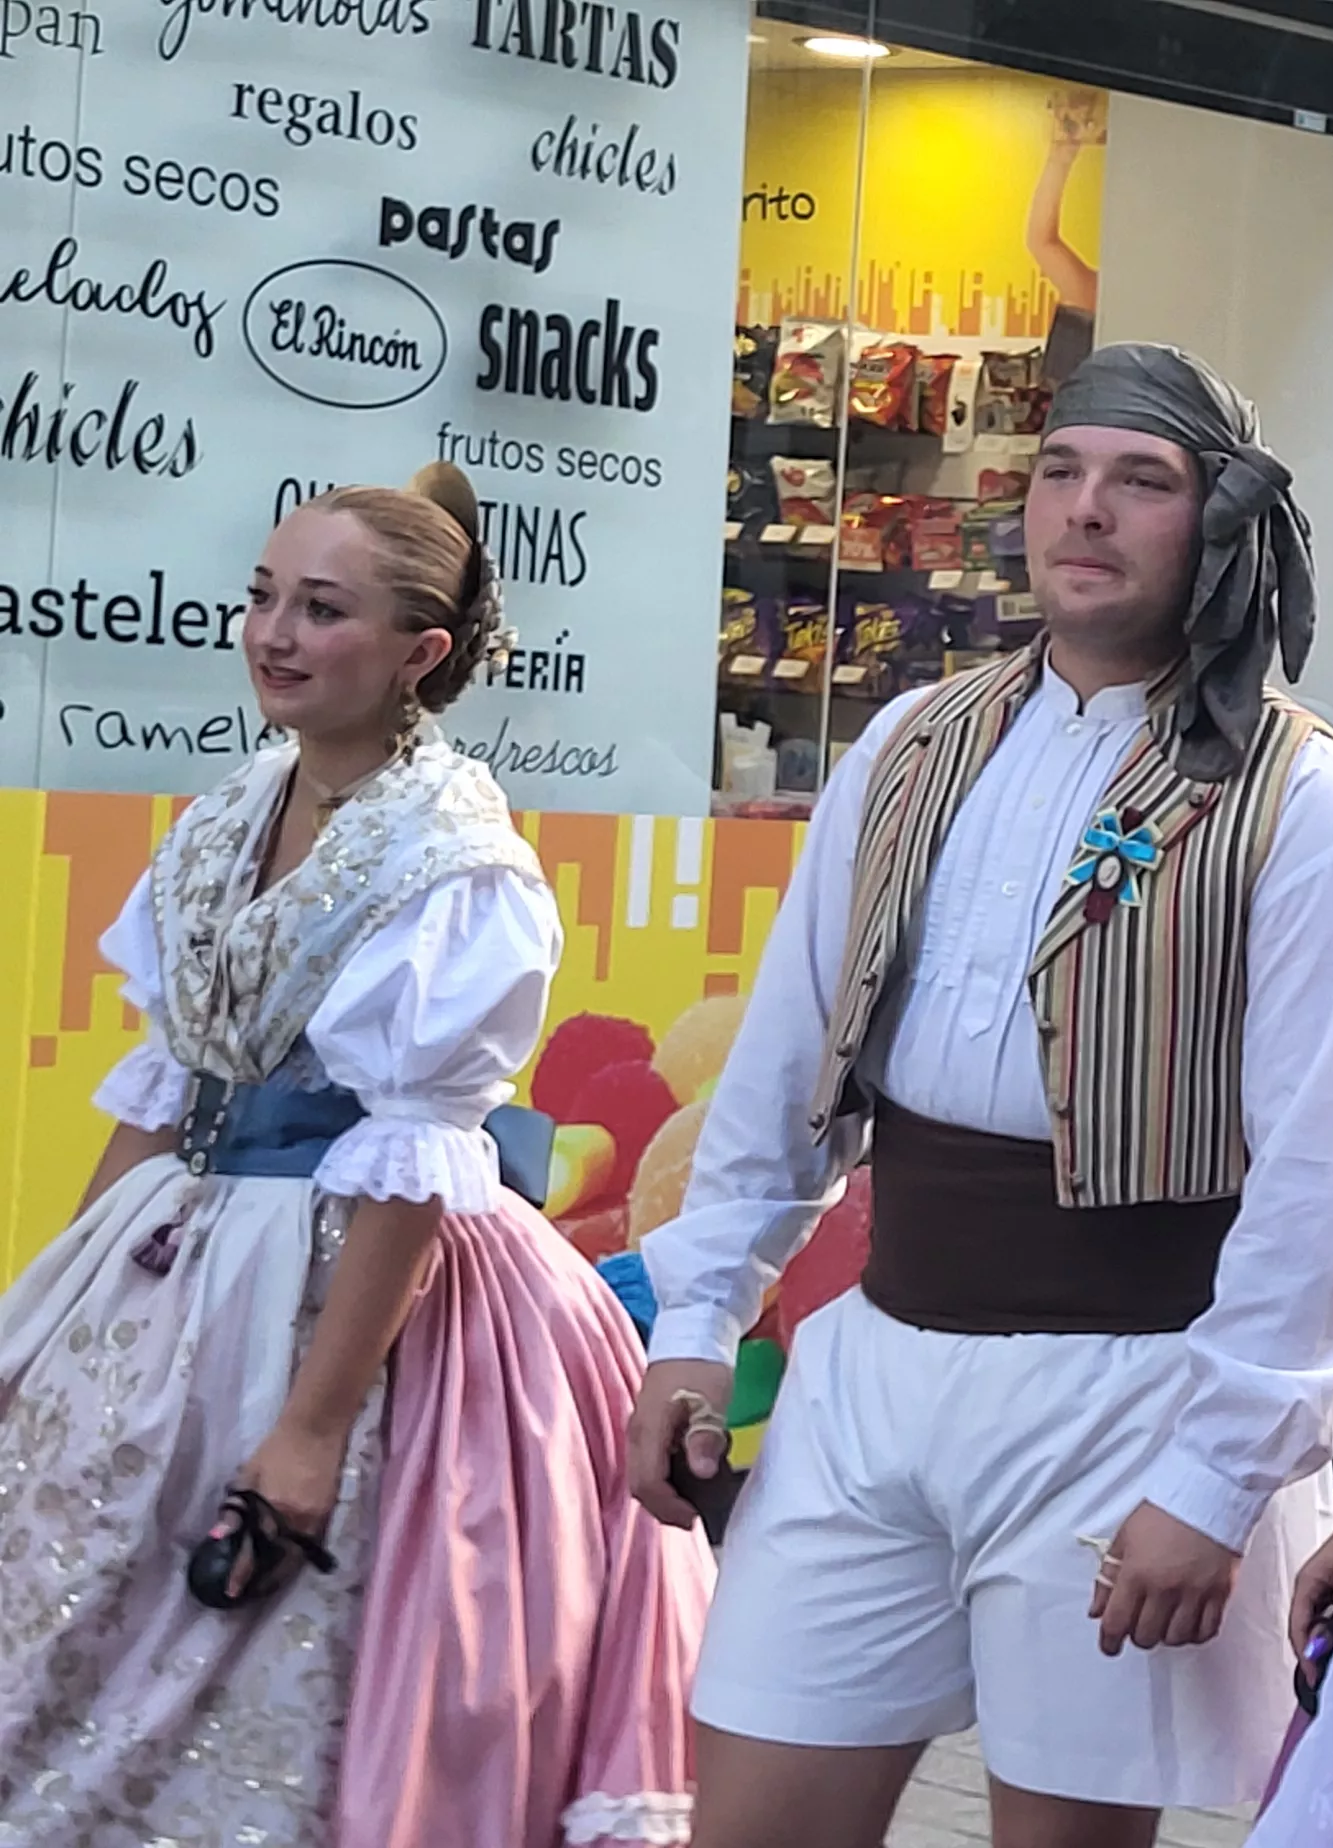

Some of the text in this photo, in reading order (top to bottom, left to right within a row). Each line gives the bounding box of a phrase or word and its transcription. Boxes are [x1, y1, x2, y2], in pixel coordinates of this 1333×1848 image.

[471, 0, 681, 90] TARTAS
[230, 82, 419, 151] regalos
[123, 154, 280, 218] secos
[530, 113, 677, 196] chicles
[379, 196, 562, 274] pastas
[269, 300, 422, 371] El Rincón
[476, 298, 660, 413] snacks
[0, 371, 204, 478] hicles
[437, 421, 662, 487] frutos secos
[452, 716, 620, 780] refrescos
